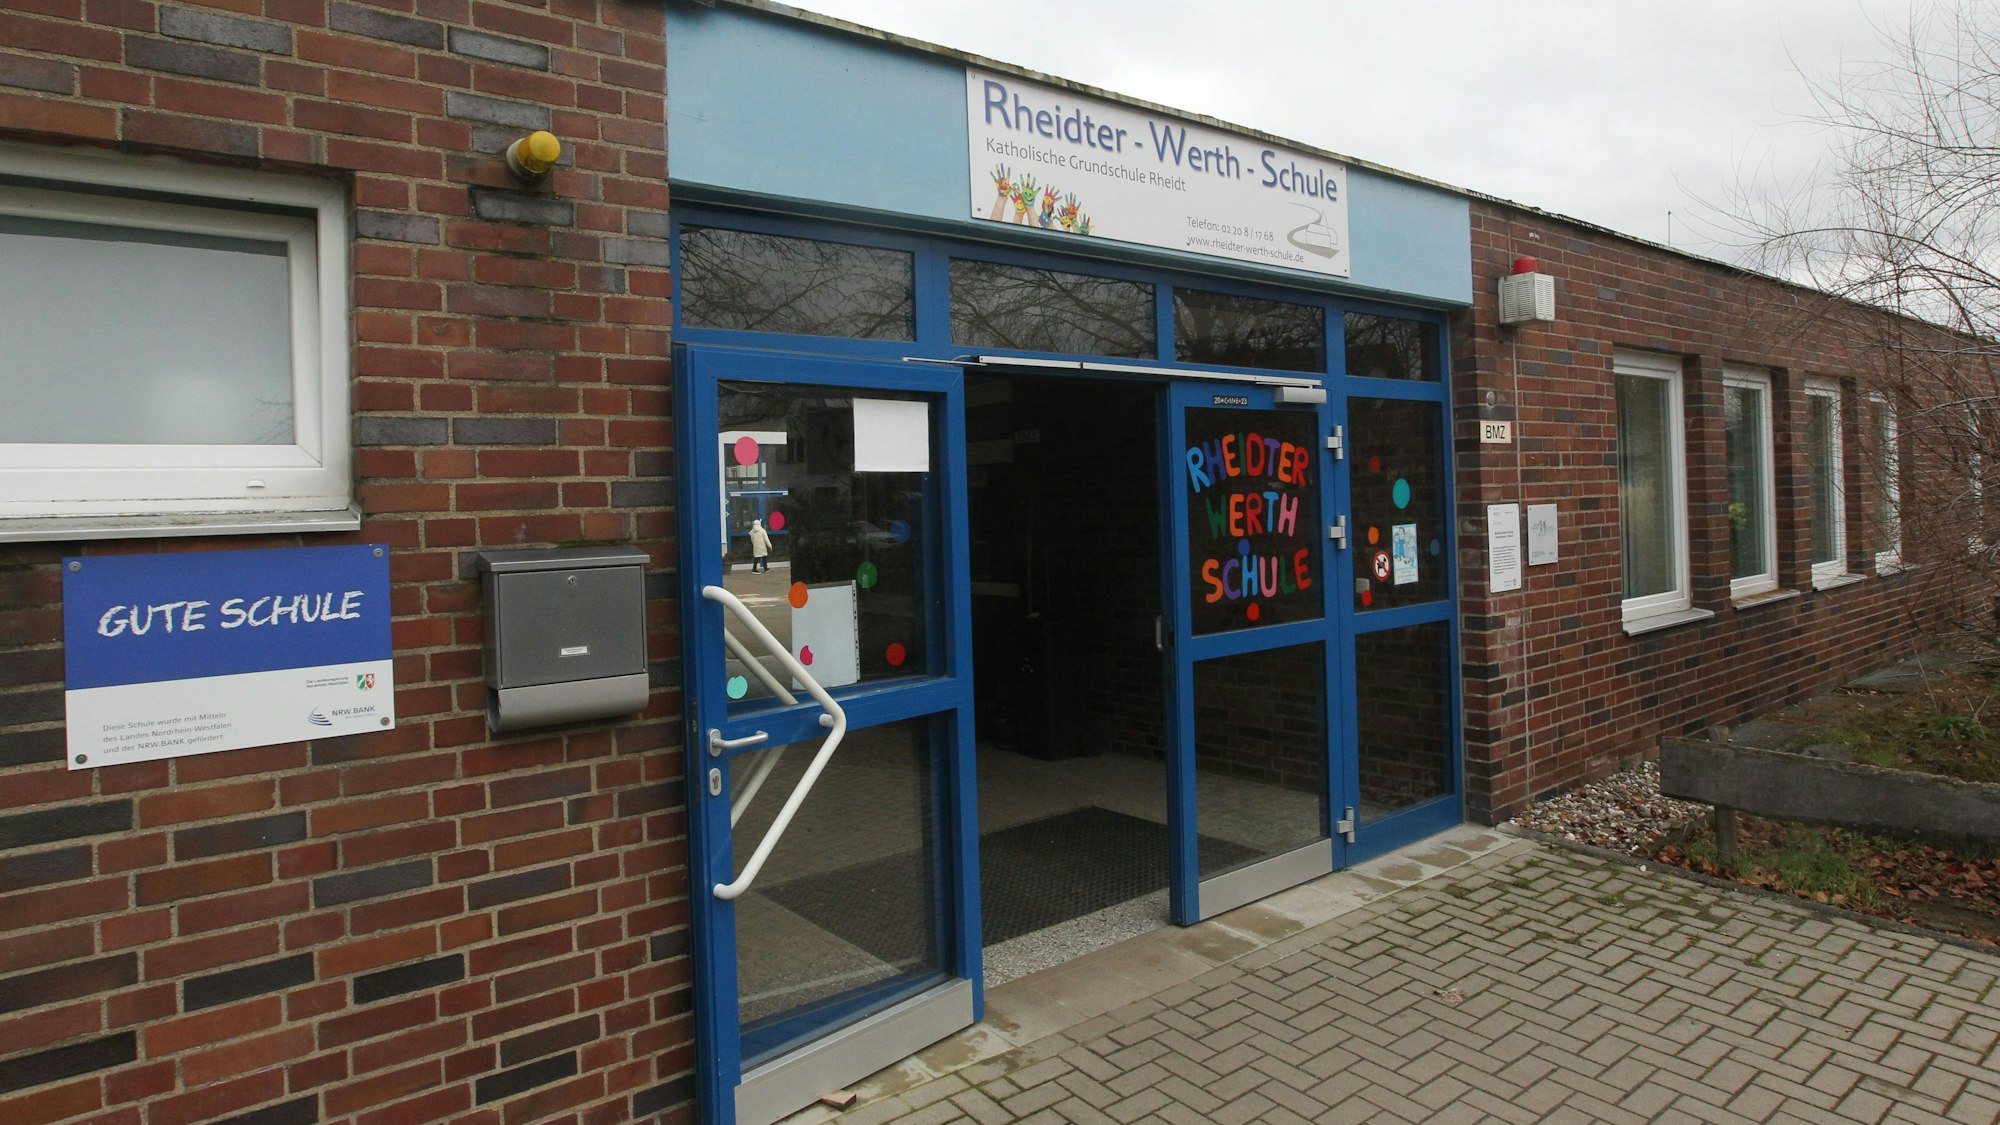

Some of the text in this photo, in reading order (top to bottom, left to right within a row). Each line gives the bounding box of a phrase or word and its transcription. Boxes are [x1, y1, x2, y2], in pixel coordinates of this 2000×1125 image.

[983, 79, 1127, 153] Rheidter
[1149, 121, 1240, 179] Werth
[1261, 149, 1337, 201] Schule
[986, 137, 1186, 192] Katholische Grundschule Rheidt
[1187, 216, 1220, 231] Telefon:
[1221, 224, 1231, 234] 02
[1232, 226, 1242, 236] 20
[1244, 227, 1249, 236] 8
[1264, 231, 1274, 242] 68
[1187, 236, 1304, 262] www.rheidter-werth-schule.de
[1485, 424, 1506, 440] BMZ
[1186, 432, 1309, 493] RHEIDTER
[1205, 491, 1298, 540] WERTH
[1201, 548, 1312, 603] SCHULE
[97, 590, 365, 638] GUTE SCHULE
[102, 712, 227, 732] Diese Schule wurde mit Mitteln
[331, 705, 376, 717] NRW.BANK
[102, 721, 232, 743] des Landes Nordrhein-Westfalen
[103, 733, 224, 754] und der NRW.BANK gefördert
